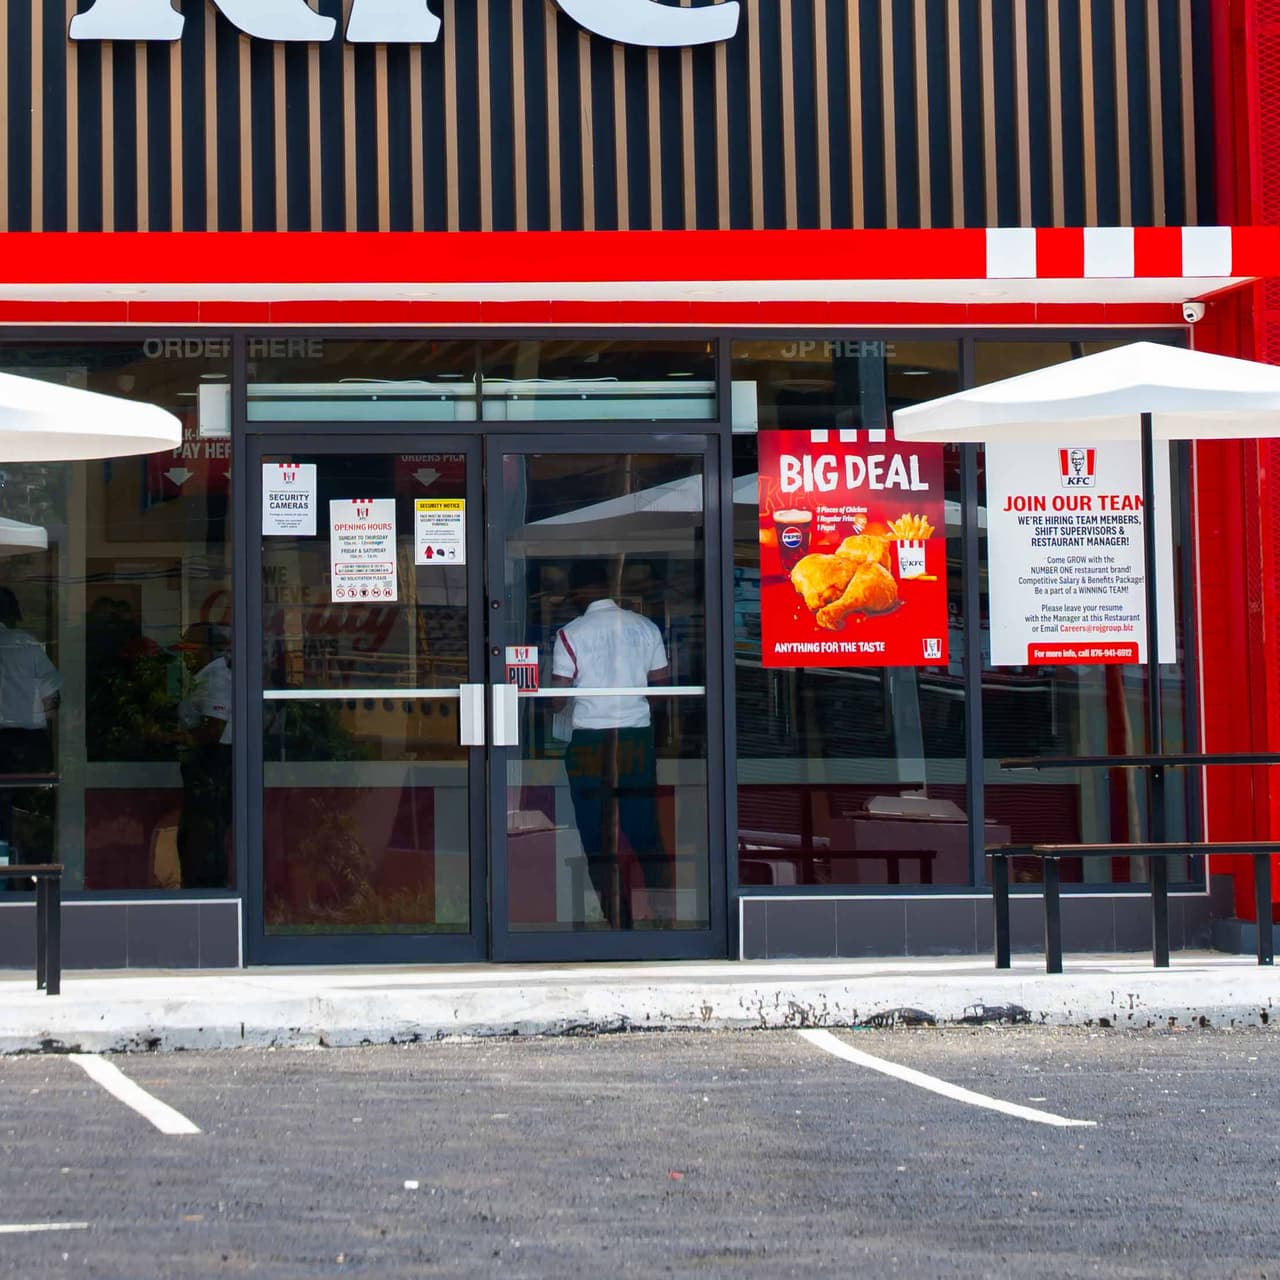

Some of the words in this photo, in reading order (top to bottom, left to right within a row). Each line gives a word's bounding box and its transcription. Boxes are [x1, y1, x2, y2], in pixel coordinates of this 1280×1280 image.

[249, 337, 324, 358] HERE
[823, 340, 897, 358] HERE
[173, 442, 201, 459] PAY
[205, 442, 231, 459] HER
[780, 454, 839, 493] BIG
[845, 453, 929, 491] DEAL
[1067, 477, 1090, 486] KFC
[269, 502, 309, 510] CAMERAS
[1003, 495, 1046, 512] JOIN
[1051, 495, 1092, 511] OUR
[821, 505, 839, 514] Pieces
[846, 505, 868, 513] Chicken
[1018, 516, 1043, 526] WE'RE
[1045, 516, 1074, 525] HIRING
[1075, 516, 1098, 525] TEAM
[1100, 515, 1142, 526] MEMBERS,
[335, 523, 367, 532] OPENING
[368, 523, 393, 531] HOURS
[1035, 527, 1059, 536] SHIFT
[1060, 526, 1117, 536] SUPERVISORS
[1118, 526, 1125, 535] &
[1031, 538, 1084, 547] RESTAURANT
[1086, 537, 1130, 547] MANAGER!
[1047, 556, 1066, 564] Come
[1066, 556, 1087, 564] GROW
[1088, 555, 1103, 563] with
[1104, 555, 1115, 563] the
[1030, 566, 1058, 574] NUMBER
[1059, 566, 1073, 574] ONE
[1074, 566, 1109, 574] restaurant
[1110, 565, 1132, 574] brand!
[1018, 577, 1058, 585] Competitive
[1059, 576, 1080, 586] Salary
[1081, 576, 1087, 584] &
[1087, 576, 1115, 584] Benefits
[1115, 576, 1145, 585] Package!
[264, 586, 311, 604] LIEVE
[1034, 587, 1043, 595] Be
[1049, 587, 1063, 596] part
[1064, 586, 1072, 594] of
[1078, 586, 1108, 594] WINNING
[1109, 586, 1129, 594] TEAM!
[1041, 604, 1063, 612] Please
[1064, 604, 1082, 612] leave
[1082, 605, 1098, 614] your
[1052, 614, 1081, 623] Manager
[1082, 614, 1089, 622] at
[1090, 614, 1103, 622] this
[1104, 614, 1141, 622] Restaurant
[1040, 624, 1059, 633] Email
[774, 642, 820, 653] ANYTHING
[821, 642, 839, 653] FOR
[840, 642, 857, 653] THE
[857, 641, 886, 652] TASTE
[1034, 649, 1045, 658] For
[1045, 650, 1062, 658] more
[1078, 649, 1090, 657] call
[508, 666, 537, 689] PULL
